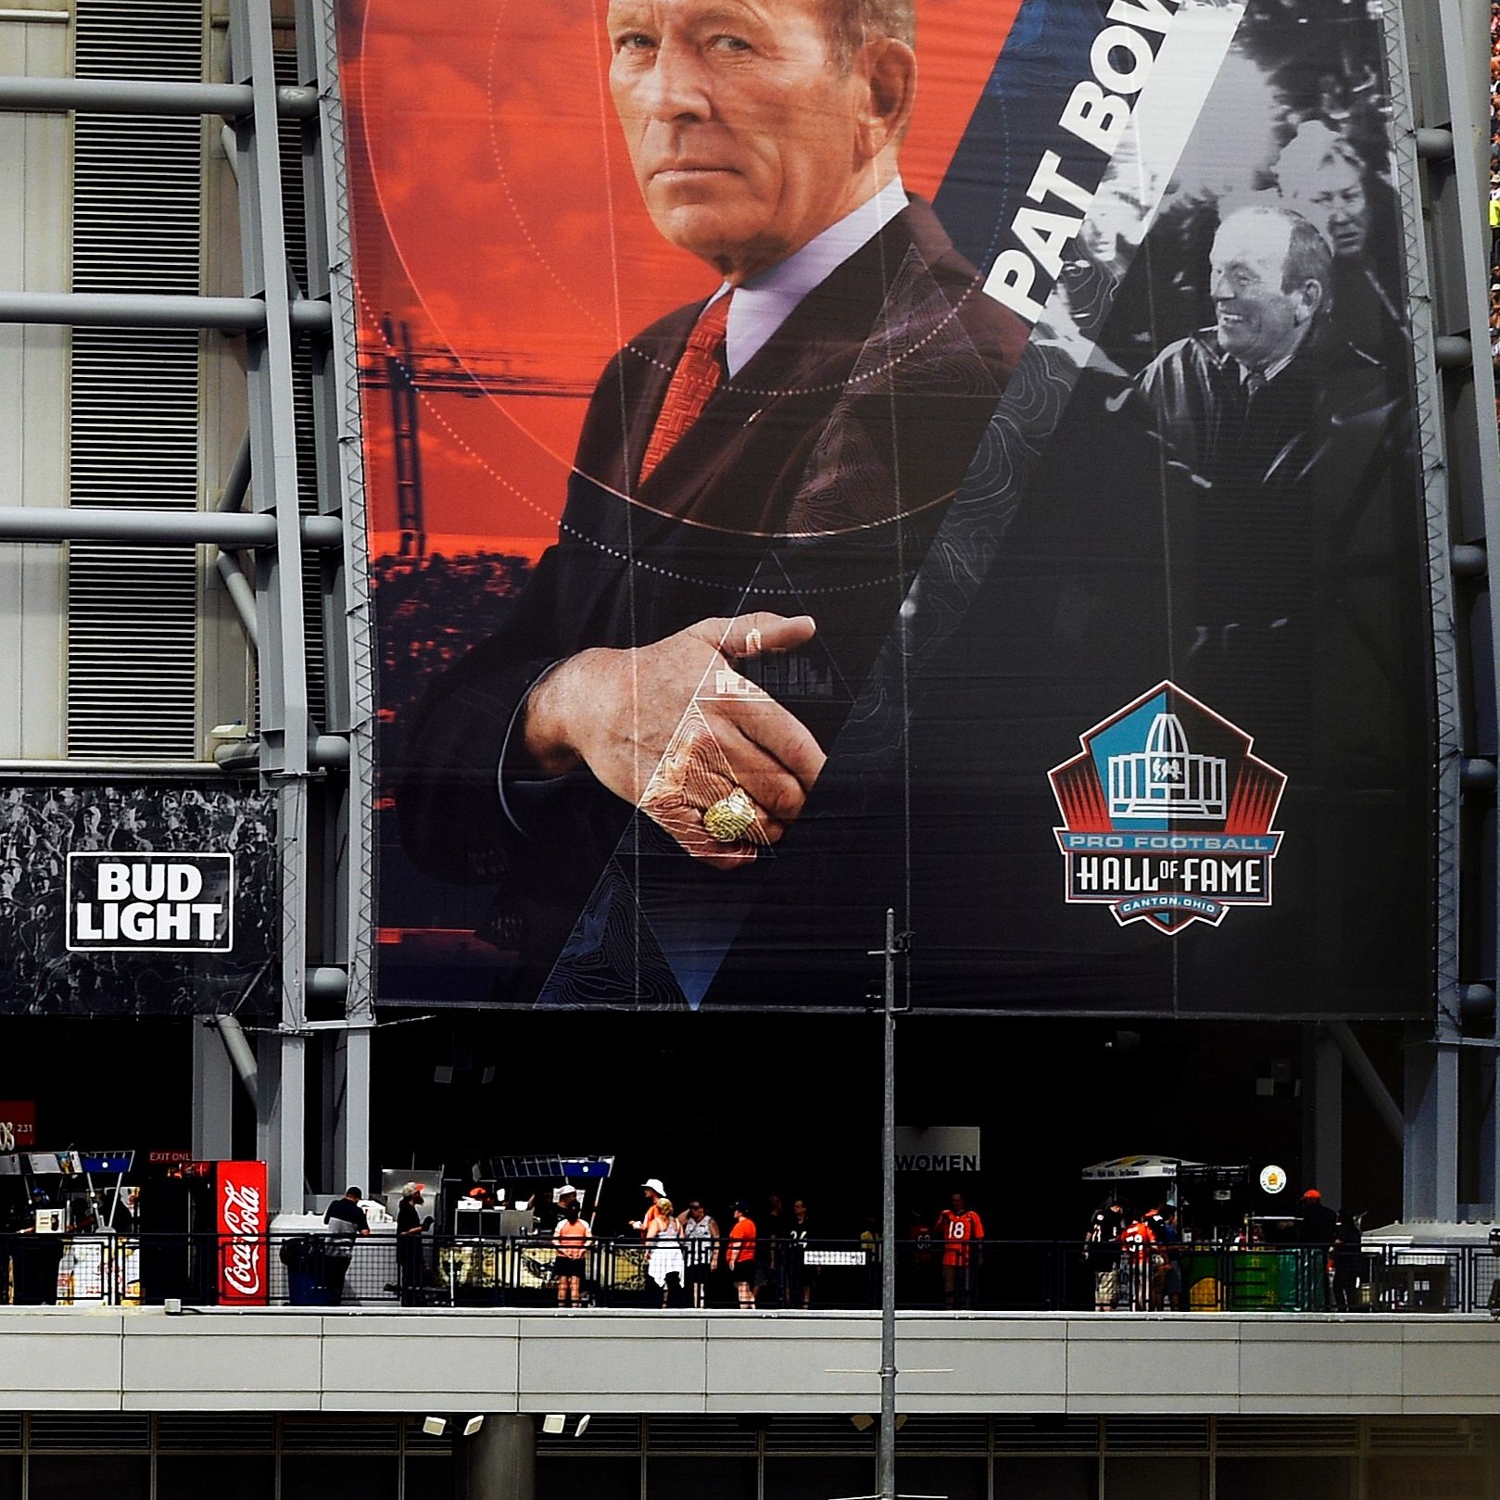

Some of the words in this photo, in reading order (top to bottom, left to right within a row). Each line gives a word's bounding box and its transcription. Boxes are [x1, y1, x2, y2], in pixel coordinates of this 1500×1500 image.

[982, 150, 1093, 324] PAT
[1069, 836, 1122, 849] PRO
[1134, 836, 1268, 851] FOOTBALL
[97, 862, 203, 901] BUD
[1076, 856, 1159, 892] HALL
[1159, 860, 1179, 880] OF
[1180, 857, 1261, 893] FAME
[1183, 897, 1216, 913] OHIO
[76, 902, 223, 941] LIGHT
[16, 1124, 33, 1133] 231
[149, 1152, 170, 1161] EXIT
[171, 1152, 192, 1162] ONL
[894, 1154, 977, 1172] WOMEN
[949, 1222, 965, 1238] 18
